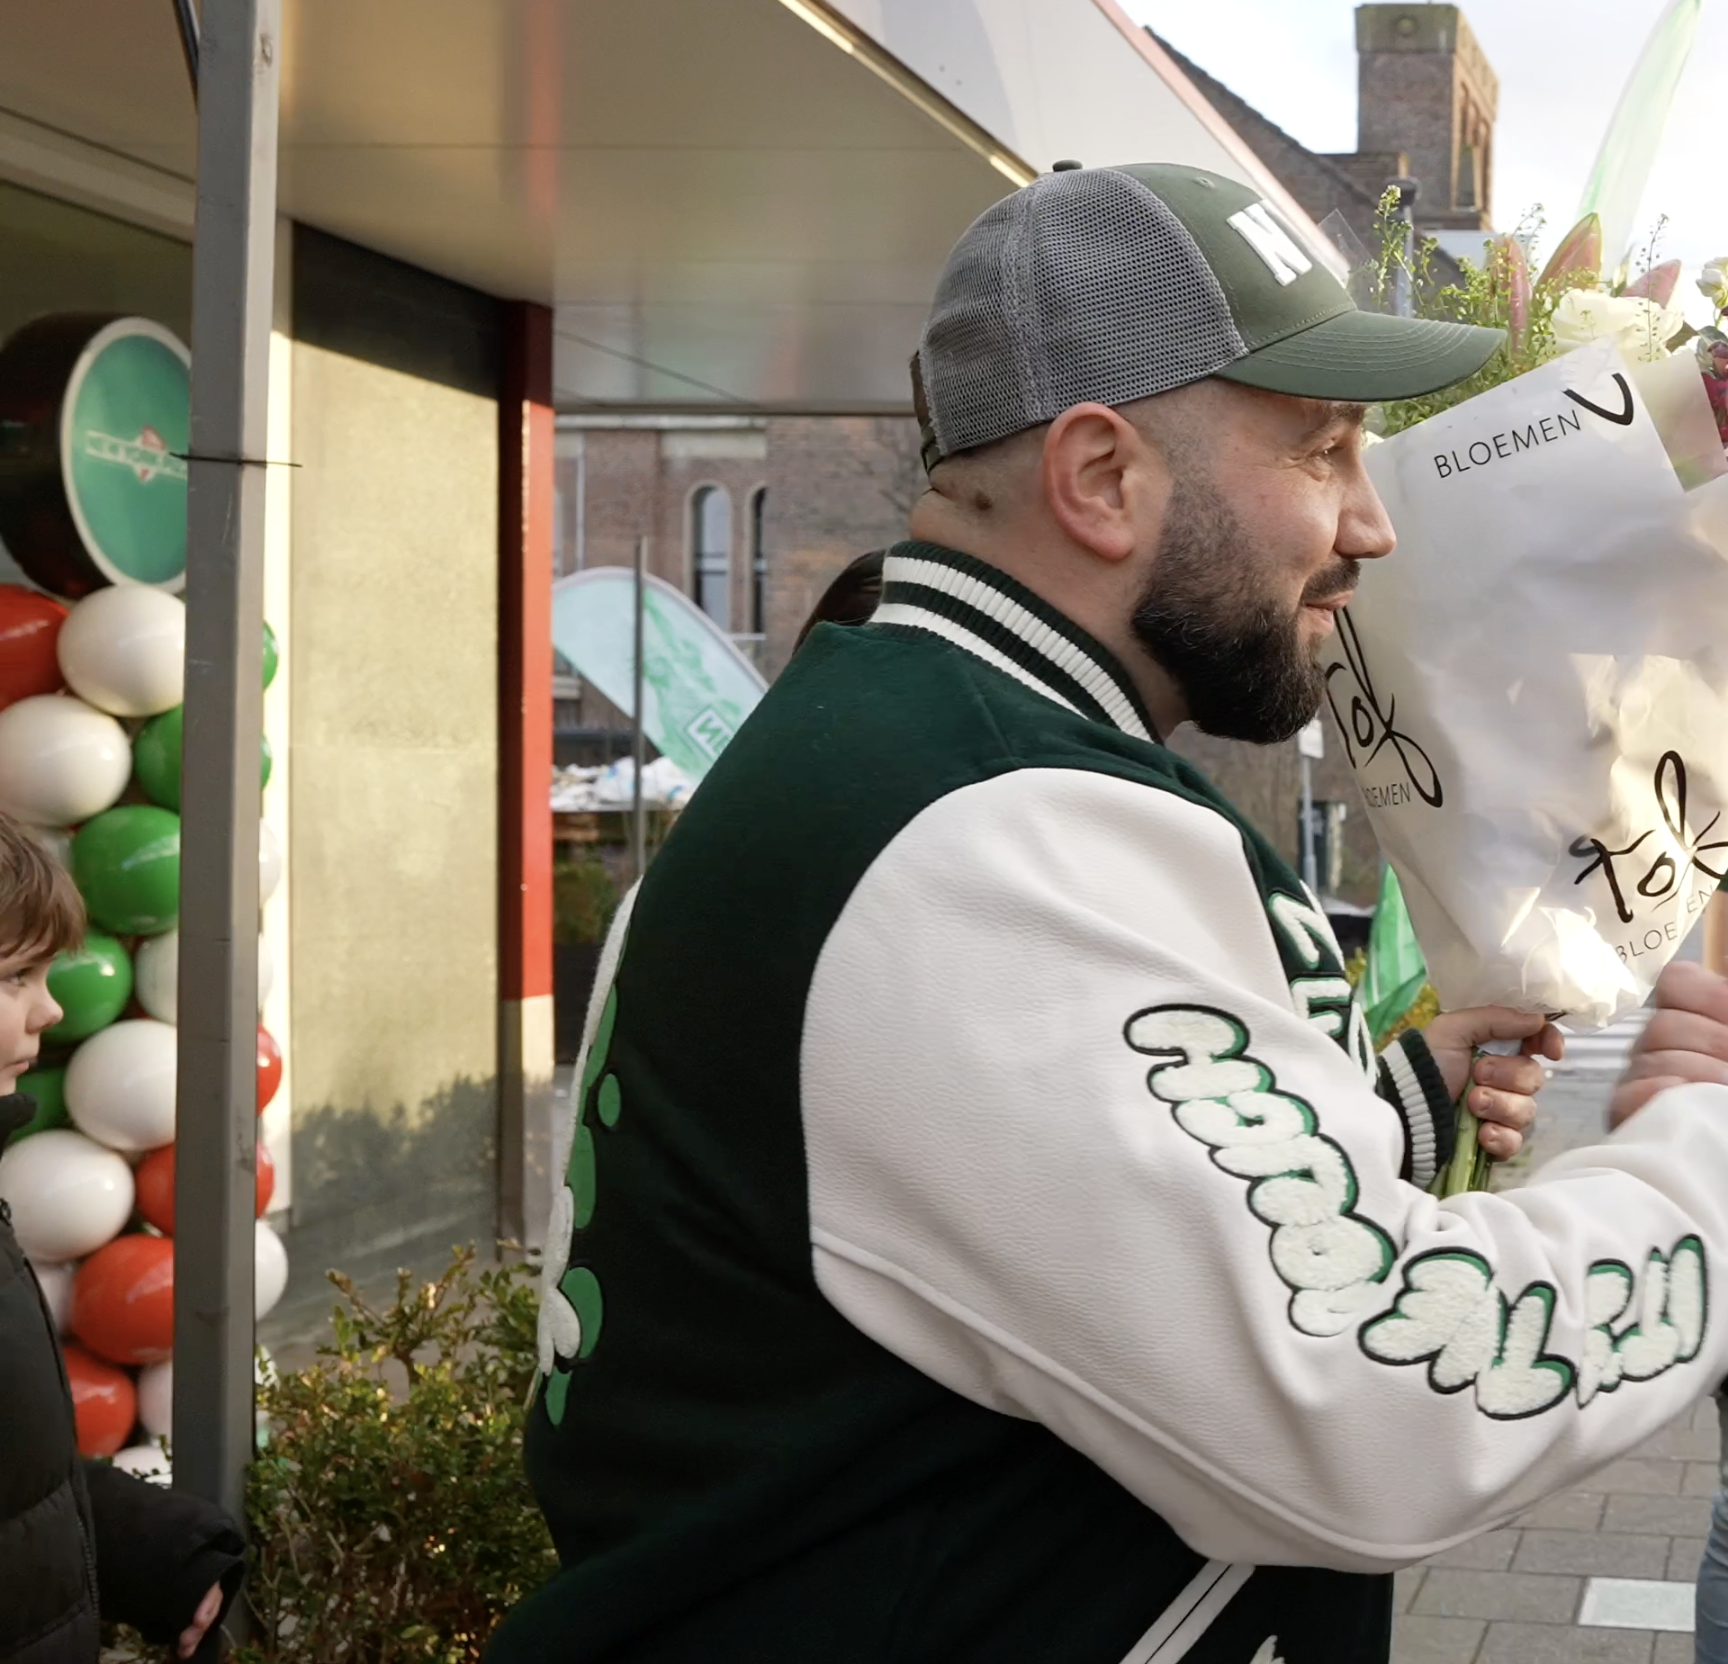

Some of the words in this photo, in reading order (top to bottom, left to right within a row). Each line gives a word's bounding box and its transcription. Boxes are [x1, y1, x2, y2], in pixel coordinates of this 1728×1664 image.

[1226, 200, 1314, 287] N
[1433, 409, 1581, 479] BLOEMEN
[1614, 884, 1714, 966] BLOEEN
